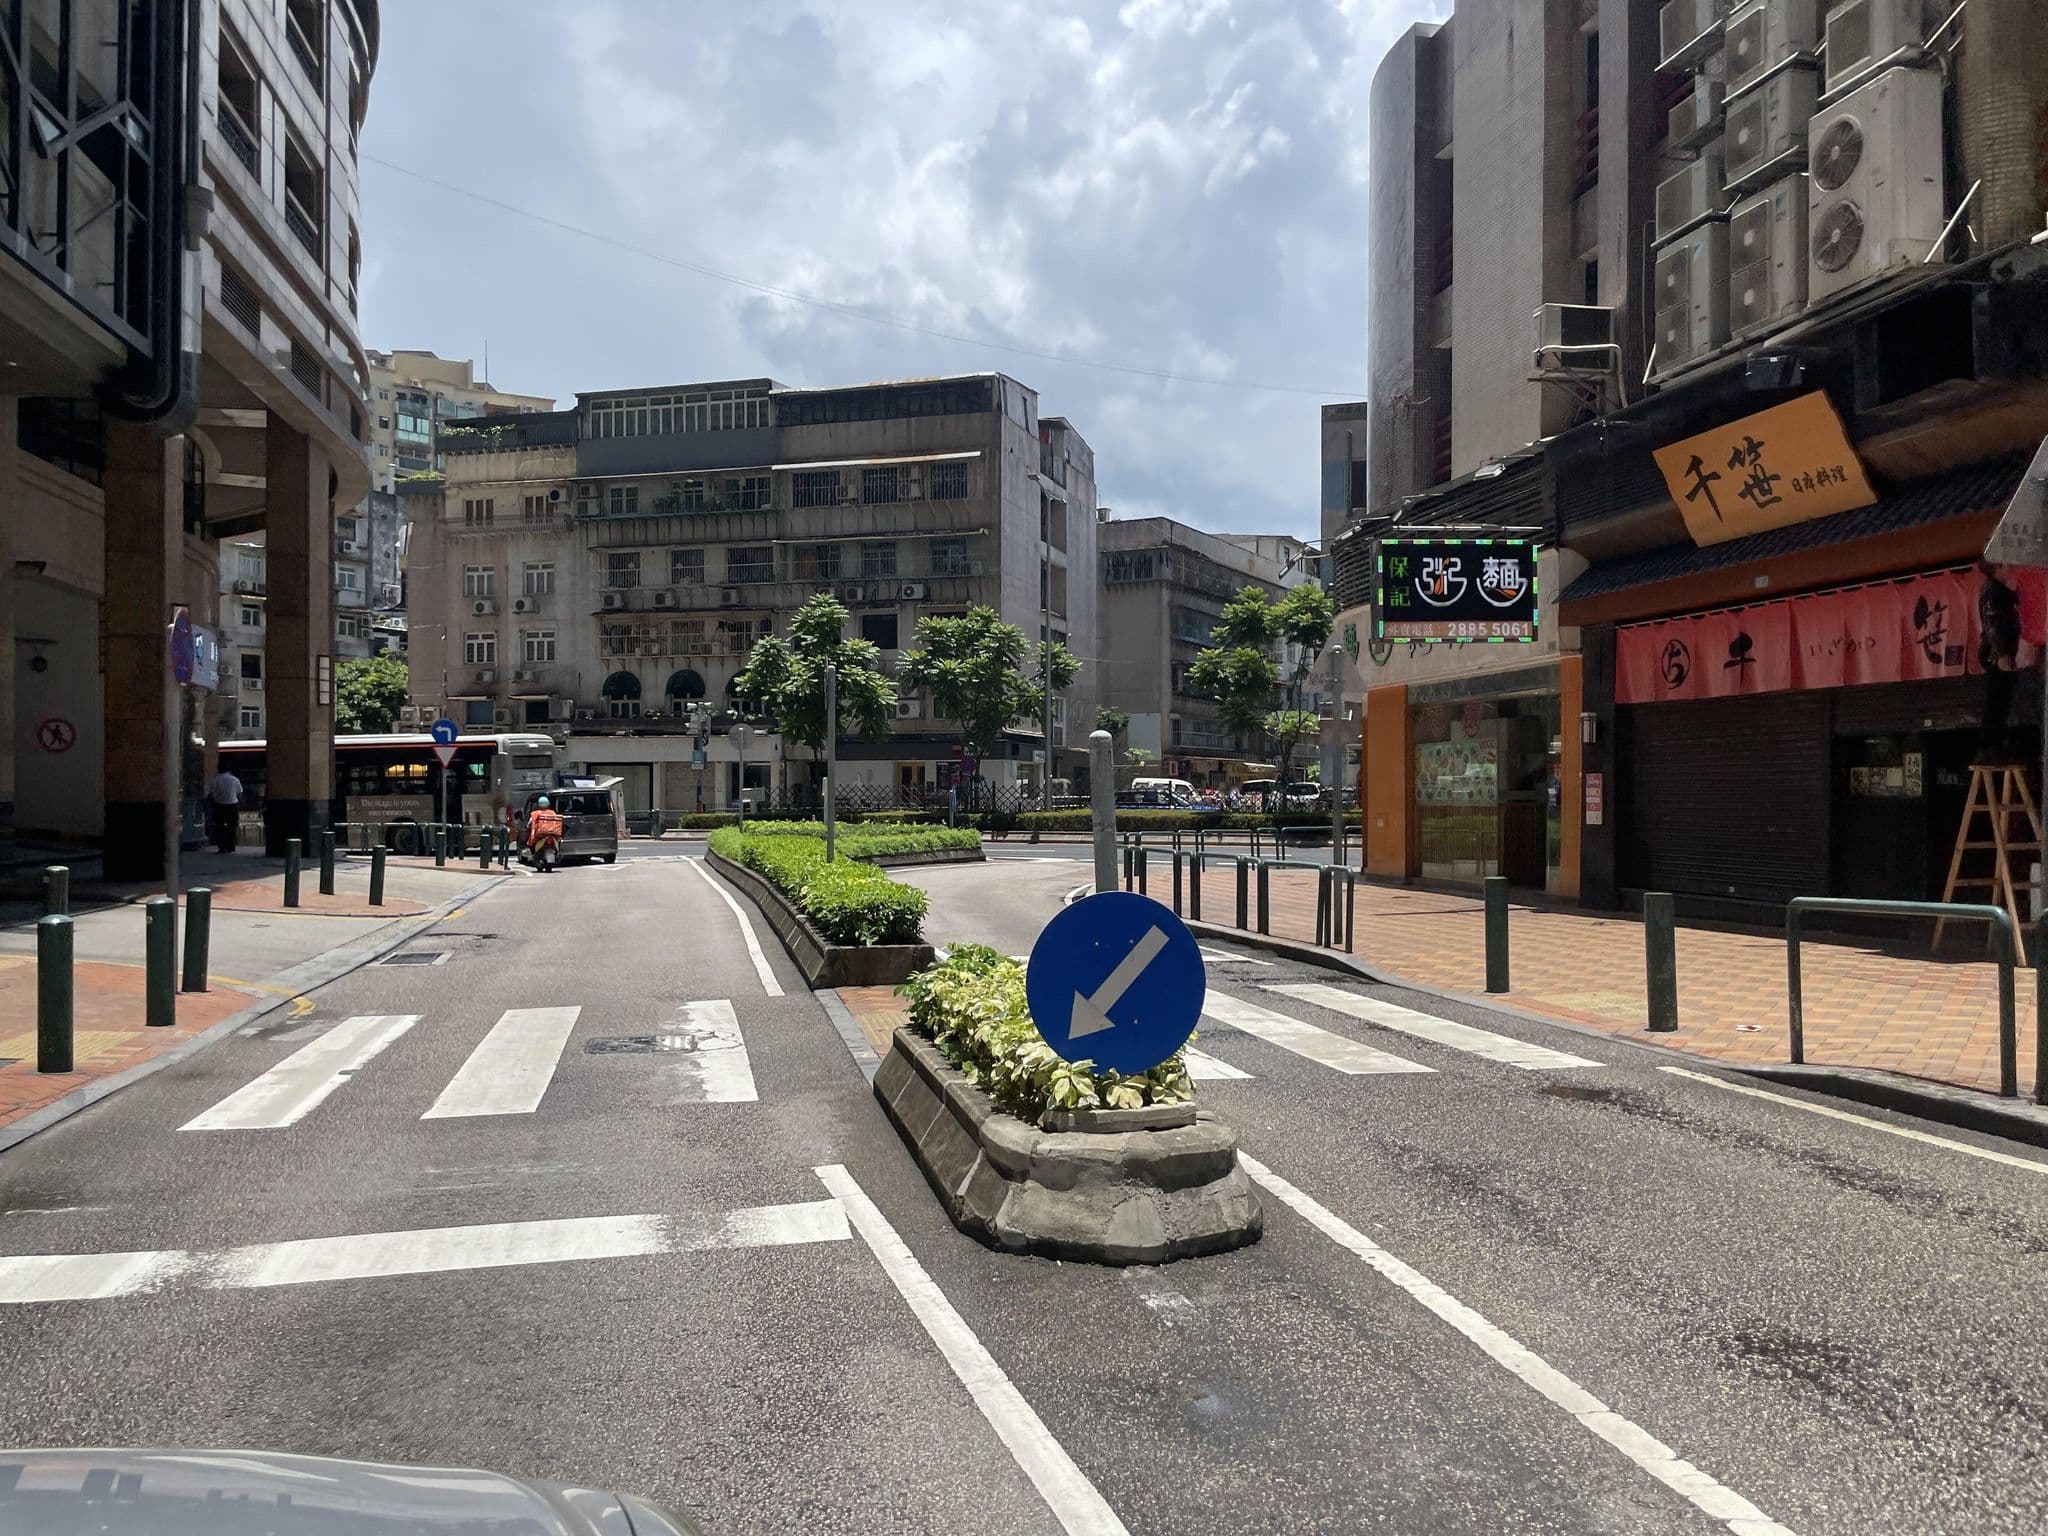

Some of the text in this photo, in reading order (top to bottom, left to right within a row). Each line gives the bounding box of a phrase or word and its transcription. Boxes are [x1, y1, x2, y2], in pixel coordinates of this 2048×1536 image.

[1388, 556, 1411, 607] 保記
[1447, 622, 1488, 637] 2885
[1491, 622, 1529, 637] 5061
[360, 799, 374, 807] The
[375, 799, 393, 809] stage
[400, 800, 421, 809] yours
